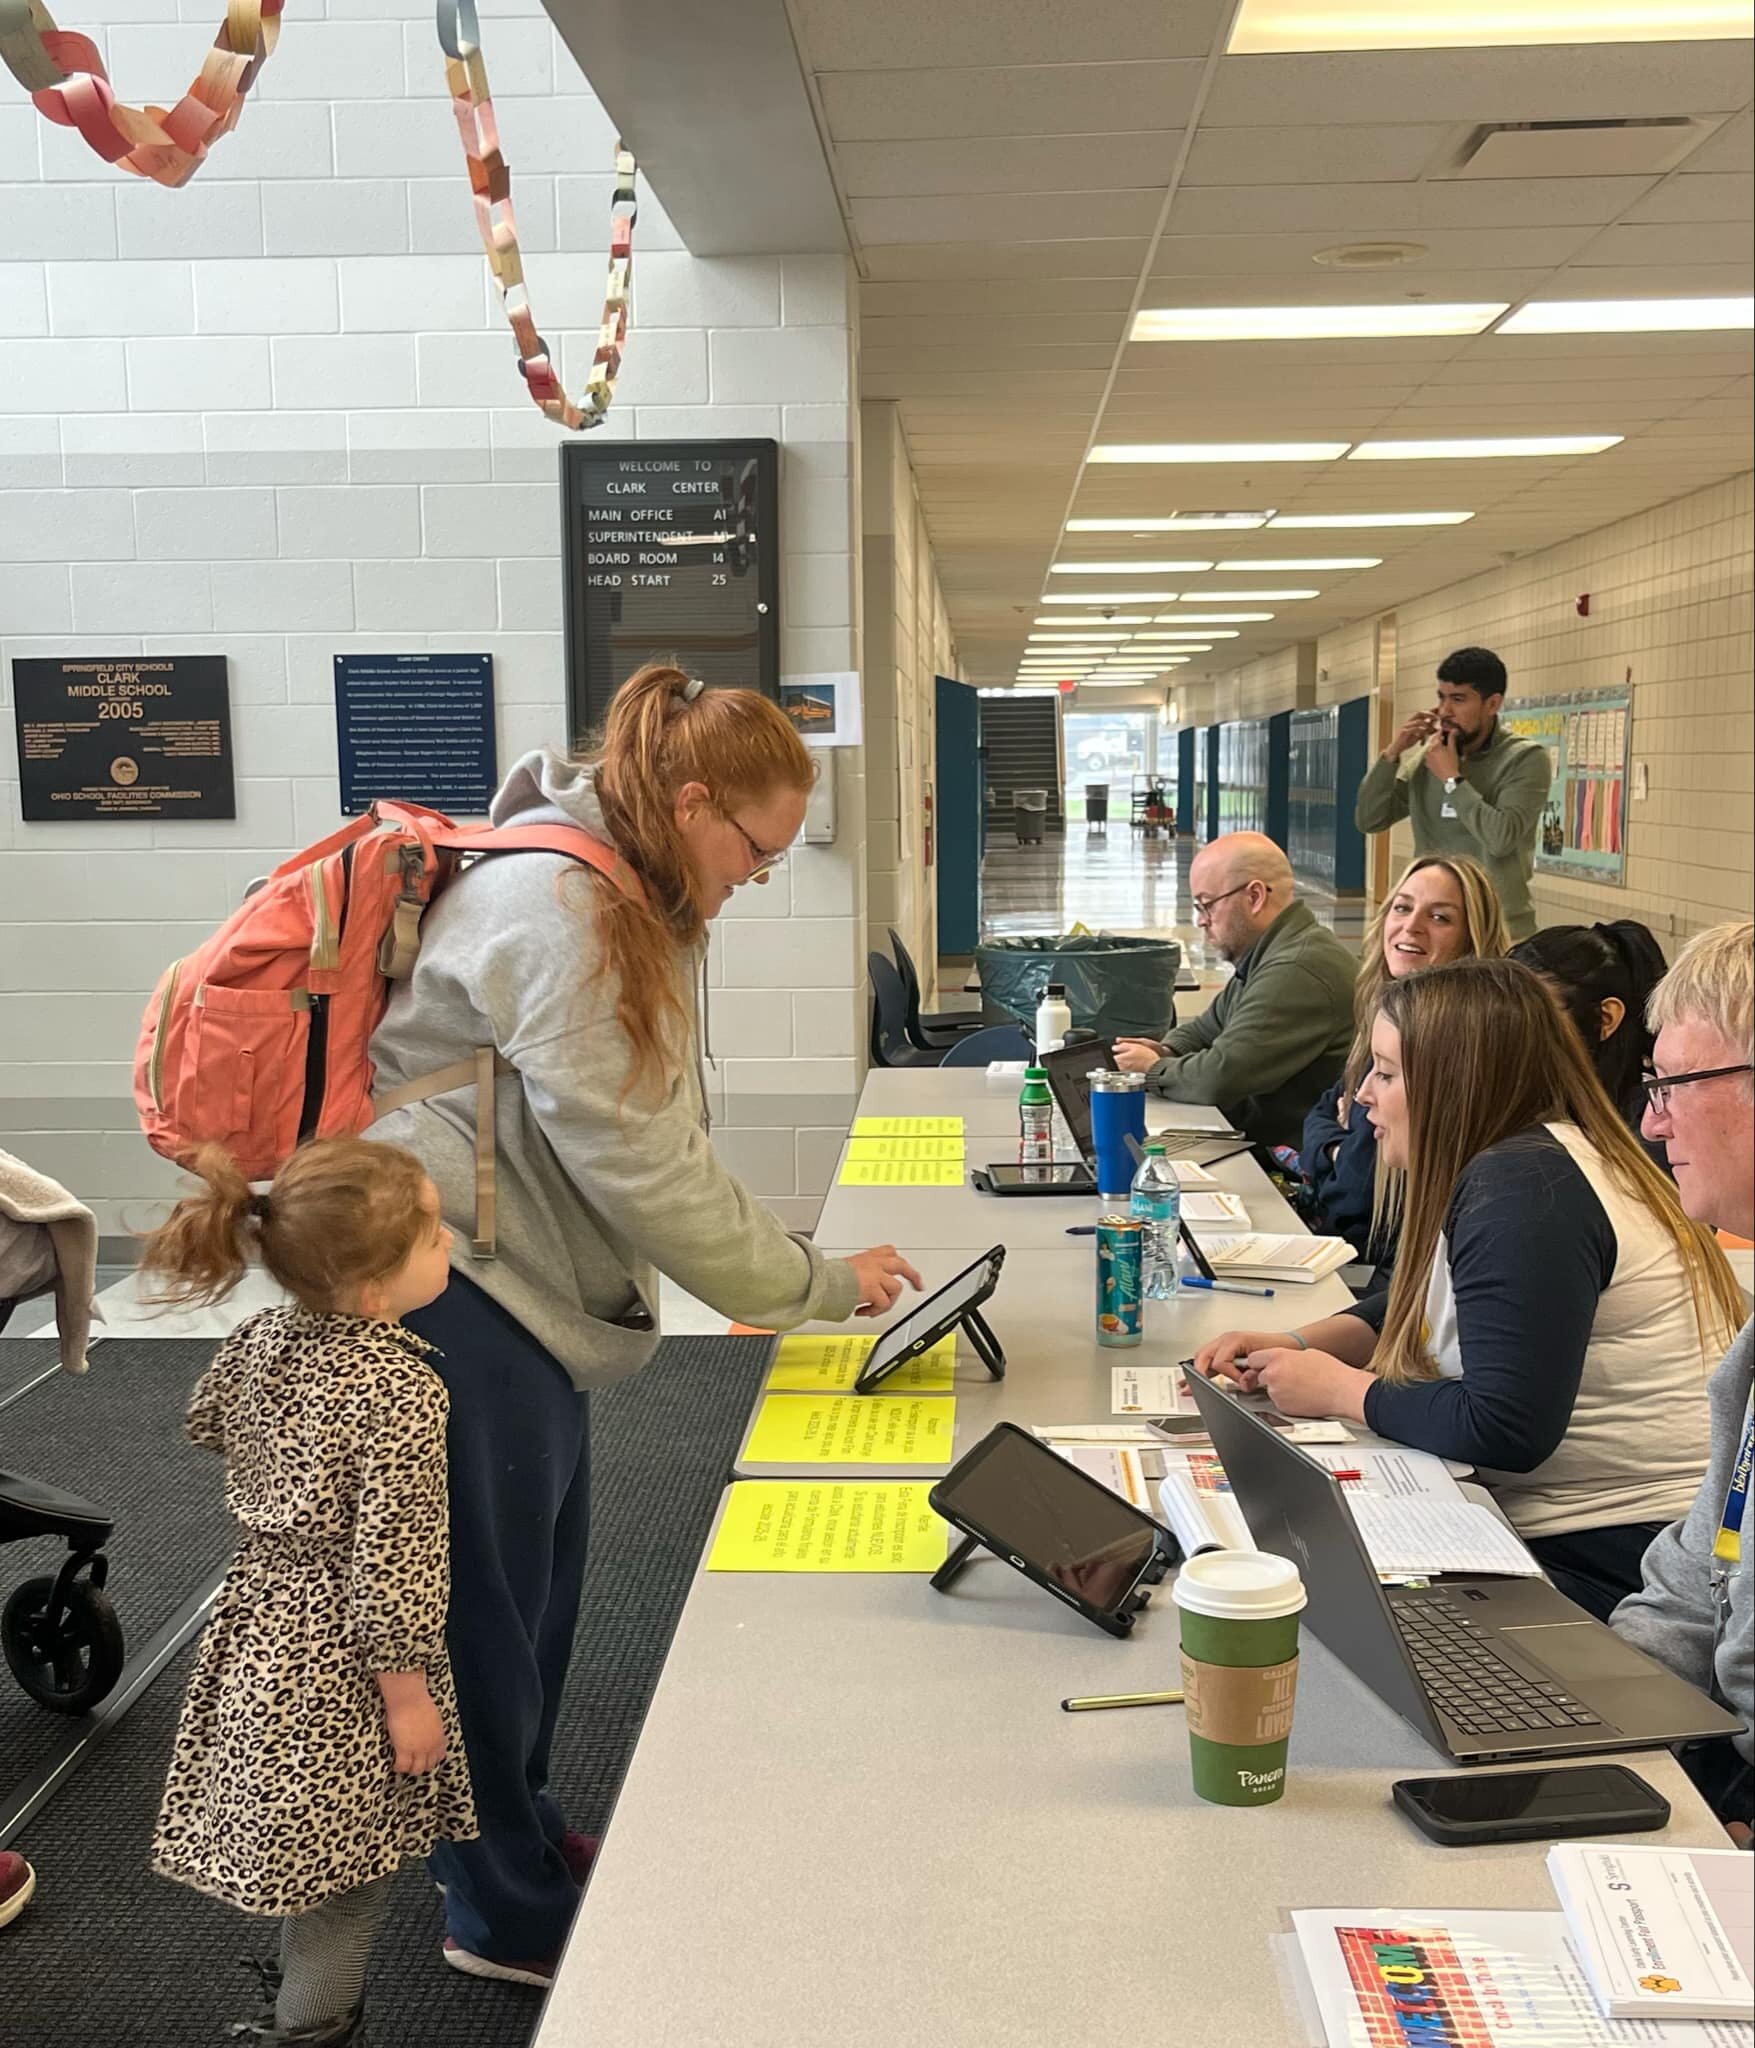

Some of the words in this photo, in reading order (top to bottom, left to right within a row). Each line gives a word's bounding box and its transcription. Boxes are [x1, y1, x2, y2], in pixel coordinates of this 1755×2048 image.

[619, 461, 680, 472] WELCOME
[695, 461, 711, 471] TO
[606, 482, 646, 494] CLARK
[672, 482, 719, 493] CENTER
[588, 510, 621, 521] MAIN
[630, 510, 673, 520] OFFICE
[588, 531, 693, 543] SUPERINTENDENT
[588, 554, 630, 564] BOARD
[639, 553, 678, 564] ROOM
[588, 575, 621, 586] HEAD
[632, 575, 670, 586] START
[712, 575, 726, 585] 25
[116, 664, 134, 672] CITY
[135, 663, 173, 671] SCHOOLS
[98, 673, 140, 683] CLARK
[67, 686, 115, 696] MIDDLE
[119, 685, 172, 696] SCHOOL
[98, 703, 143, 719] 2005
[1272, 1675, 1291, 1703] ALL
[1605, 1882, 1632, 1890] S
[1624, 1898, 1648, 1924] Passport
[1635, 1925, 1651, 1936] Fair
[1641, 1937, 1666, 1969] Enrollment
[1367, 1929, 1451, 2048] WELCOME
